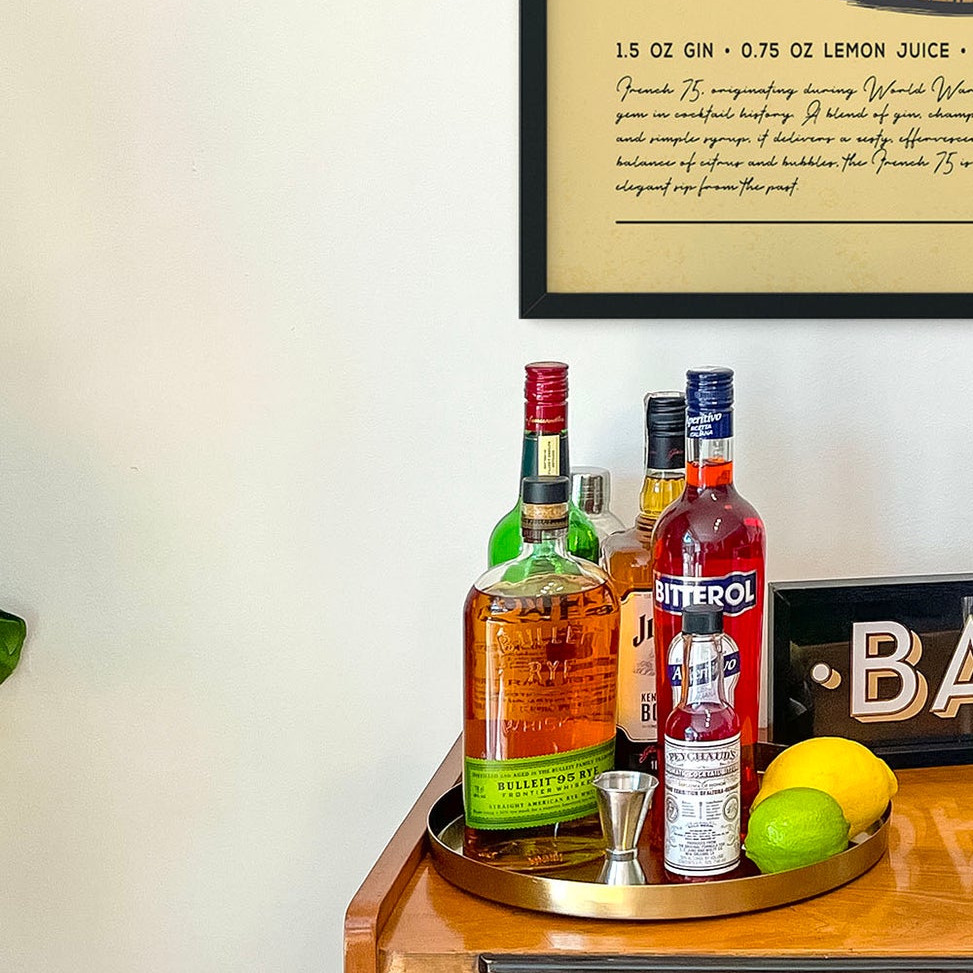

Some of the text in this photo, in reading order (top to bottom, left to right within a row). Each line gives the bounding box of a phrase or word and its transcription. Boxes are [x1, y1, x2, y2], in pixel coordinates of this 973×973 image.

[616, 42, 640, 59] 1.5
[650, 42, 673, 59] OZ
[683, 42, 713, 59] GIN
[741, 42, 780, 59] 0.75
[790, 42, 813, 59] OZ
[824, 42, 885, 59] LEMON
[896, 42, 950, 59] JUICE
[616, 75, 675, 102] French
[711, 80, 798, 101] originating
[803, 83, 858, 101] during
[863, 75, 926, 102] World
[615, 112, 648, 125] gem
[652, 109, 670, 119] in
[674, 104, 735, 124] cocktail
[801, 99, 821, 127] A
[826, 107, 868, 119] blend
[873, 103, 889, 125] of
[616, 131, 646, 143] and
[650, 131, 700, 147] simple
[757, 128, 769, 148] it
[773, 131, 835, 144] delivers
[839, 136, 851, 144] a
[616, 156, 676, 168] balance
[680, 151, 696, 173] of
[700, 152, 744, 173] citrus
[748, 155, 778, 168] and
[872, 147, 930, 175] French
[933, 150, 958, 175] 75
[960, 159, 973, 168] is
[615, 177, 672, 197] elegant
[674, 182, 697, 196] sip
[697, 176, 739, 197] from
[738, 177, 765, 197] the
[654, 579, 755, 607] BITTEROL
[497, 766, 599, 791] BULLEIT 95 RYE
